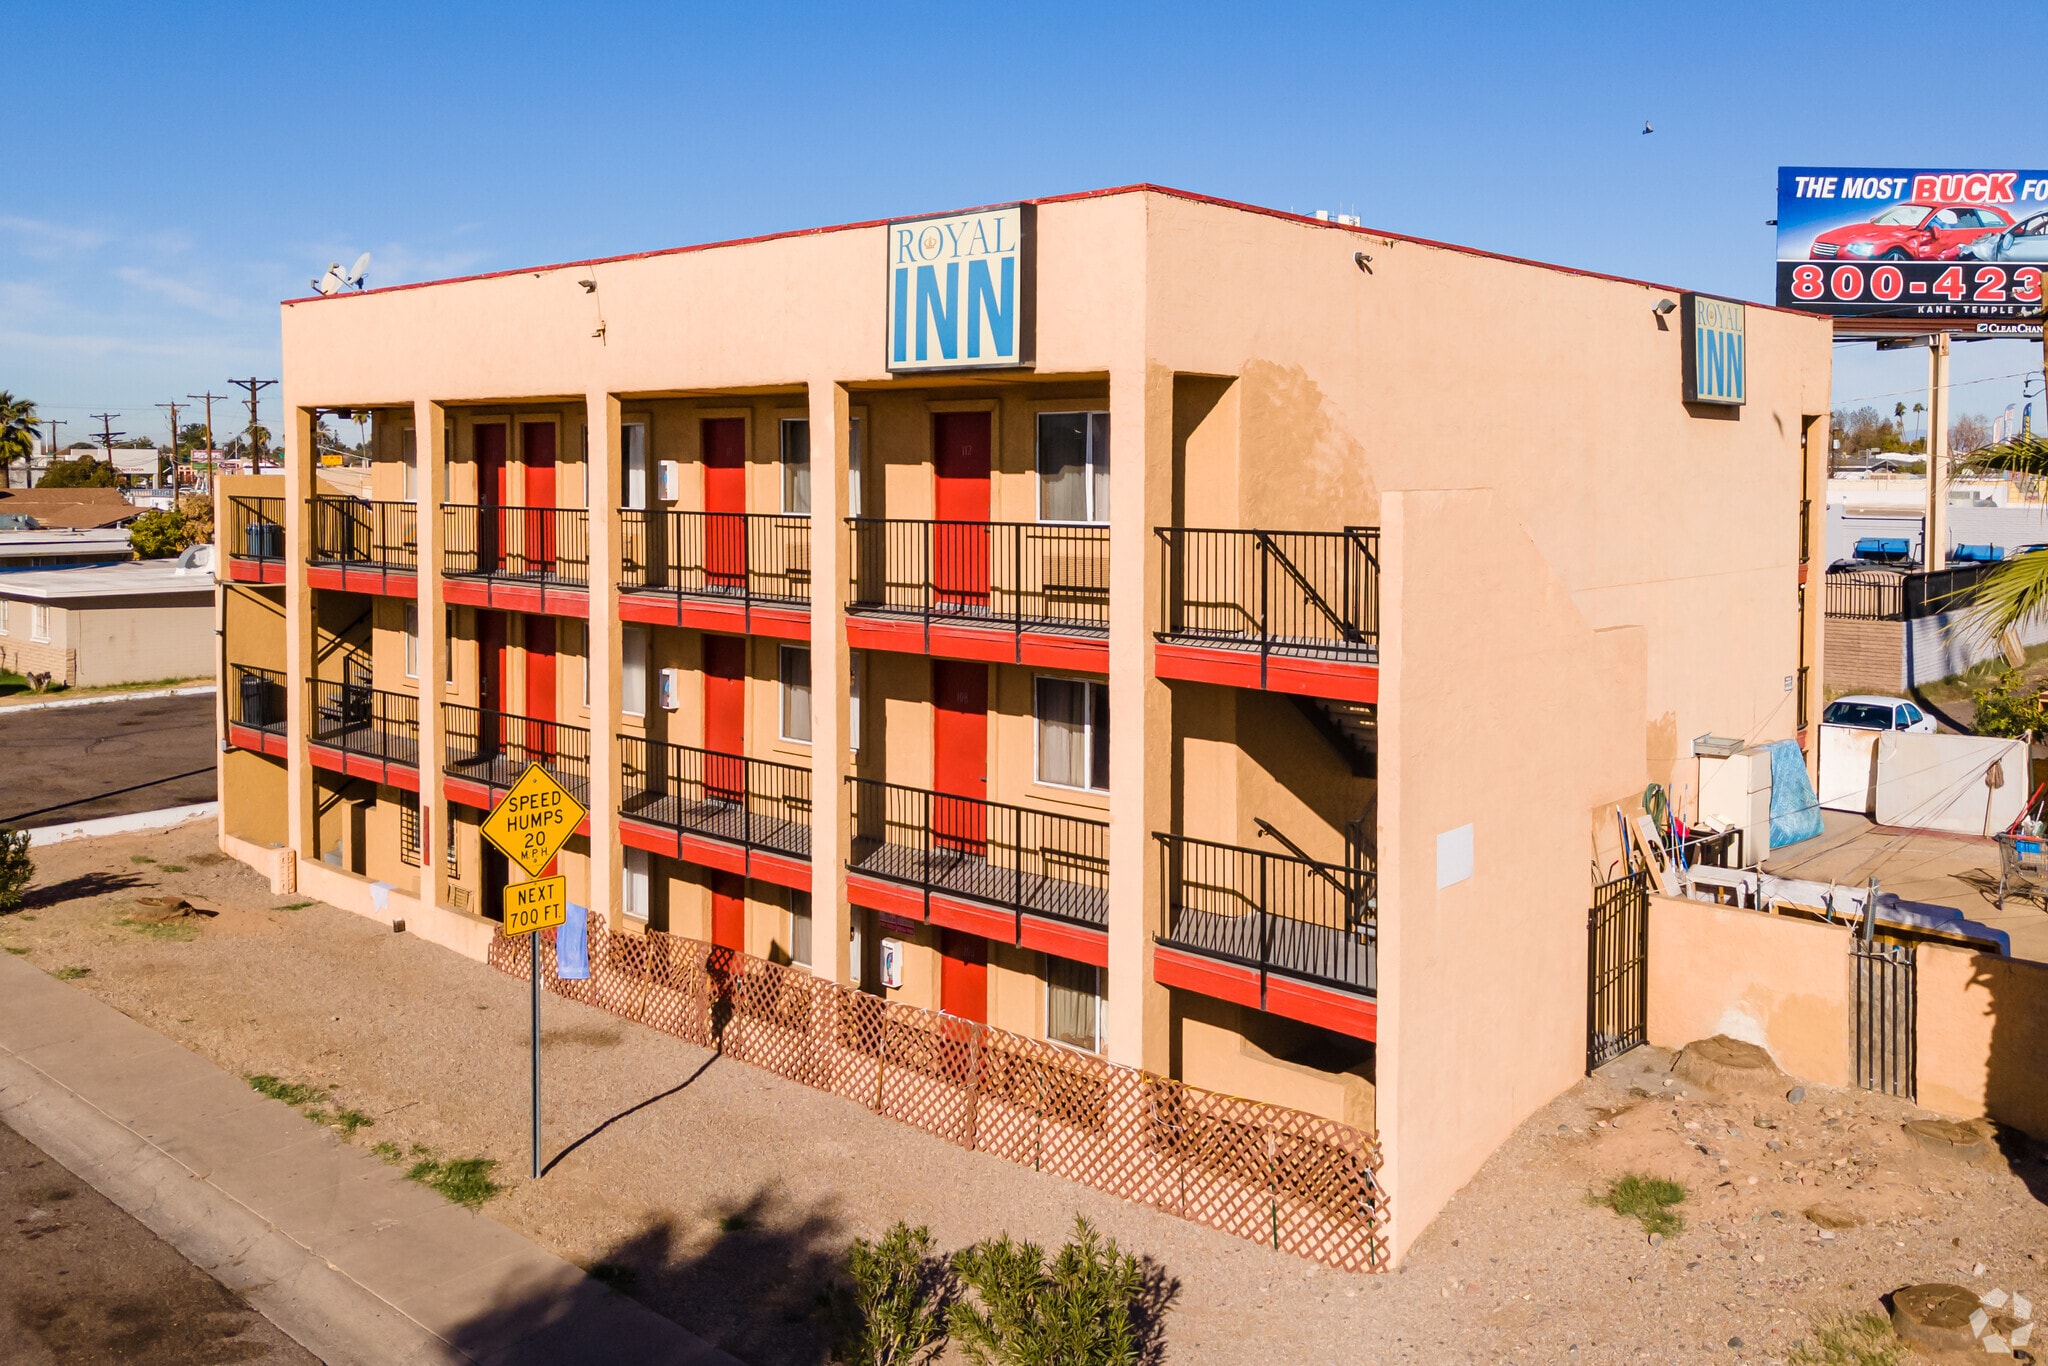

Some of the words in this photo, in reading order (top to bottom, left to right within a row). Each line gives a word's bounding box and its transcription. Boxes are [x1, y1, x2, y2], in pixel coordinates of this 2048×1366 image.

[1795, 176, 1836, 199] THE
[1841, 176, 1908, 200] MOST
[1911, 172, 2018, 204] BUCK
[2020, 179, 2048, 202] FO
[896, 216, 1016, 265] ROYAL
[1790, 264, 2042, 302] 800-423
[893, 256, 1015, 362] INN
[1697, 300, 1743, 332] ROYAL
[1917, 305, 1957, 315] KANE,
[1963, 306, 2014, 314] TEMPLE
[1697, 327, 1743, 399] INN
[509, 791, 561, 812] SPEED
[508, 809, 563, 832] HUMPS
[525, 831, 546, 848] 20
[518, 884, 555, 906] NEXT
[510, 908, 538, 928] 700
[544, 903, 561, 921] FT.
